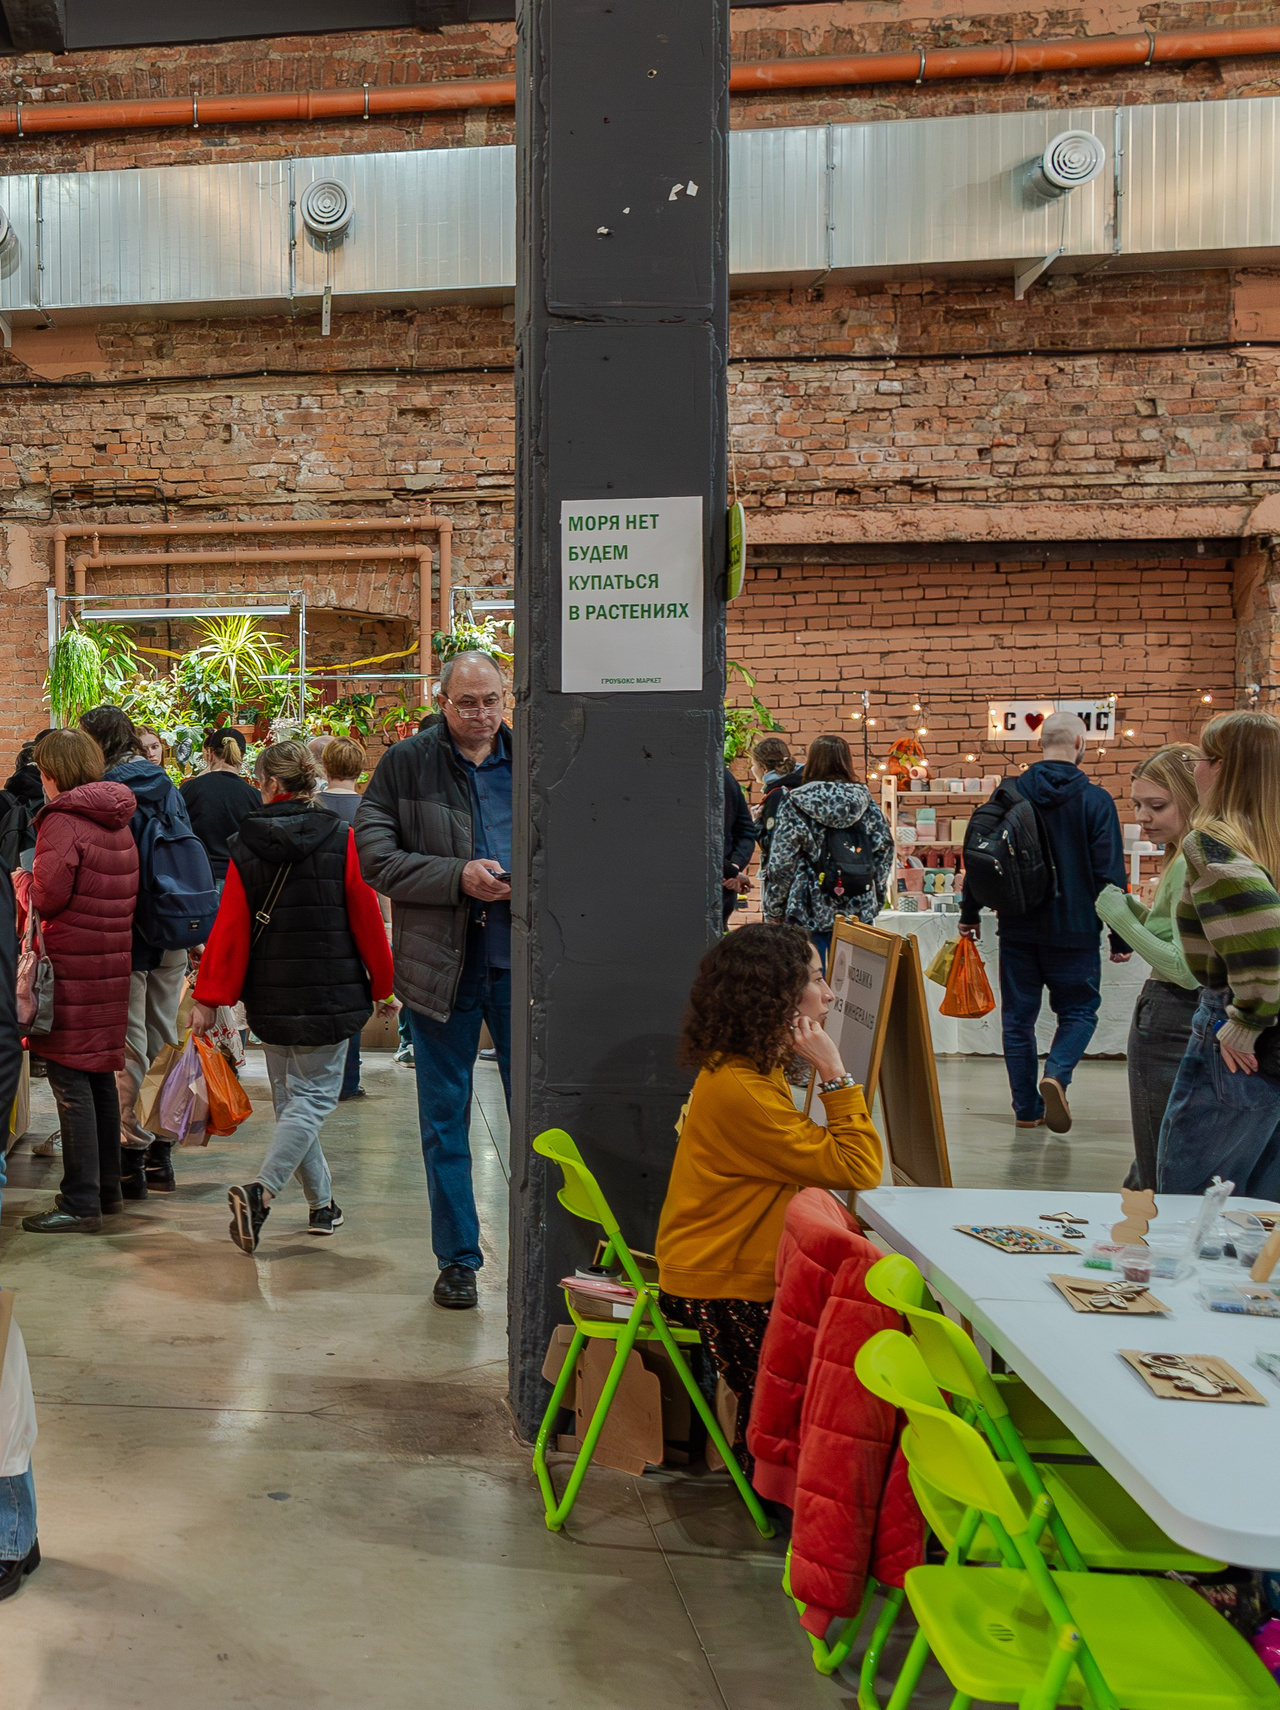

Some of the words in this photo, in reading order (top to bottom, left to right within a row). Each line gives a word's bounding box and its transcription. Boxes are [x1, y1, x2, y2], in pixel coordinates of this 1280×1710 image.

[568, 515, 619, 531] МОРЯ
[626, 514, 659, 530] НЕТ
[568, 545, 628, 562] БУДЕМ
[569, 574, 658, 590] КУПАТЬСЯ
[569, 605, 580, 620] В
[585, 603, 689, 620] РАСТЕНИЯХ
